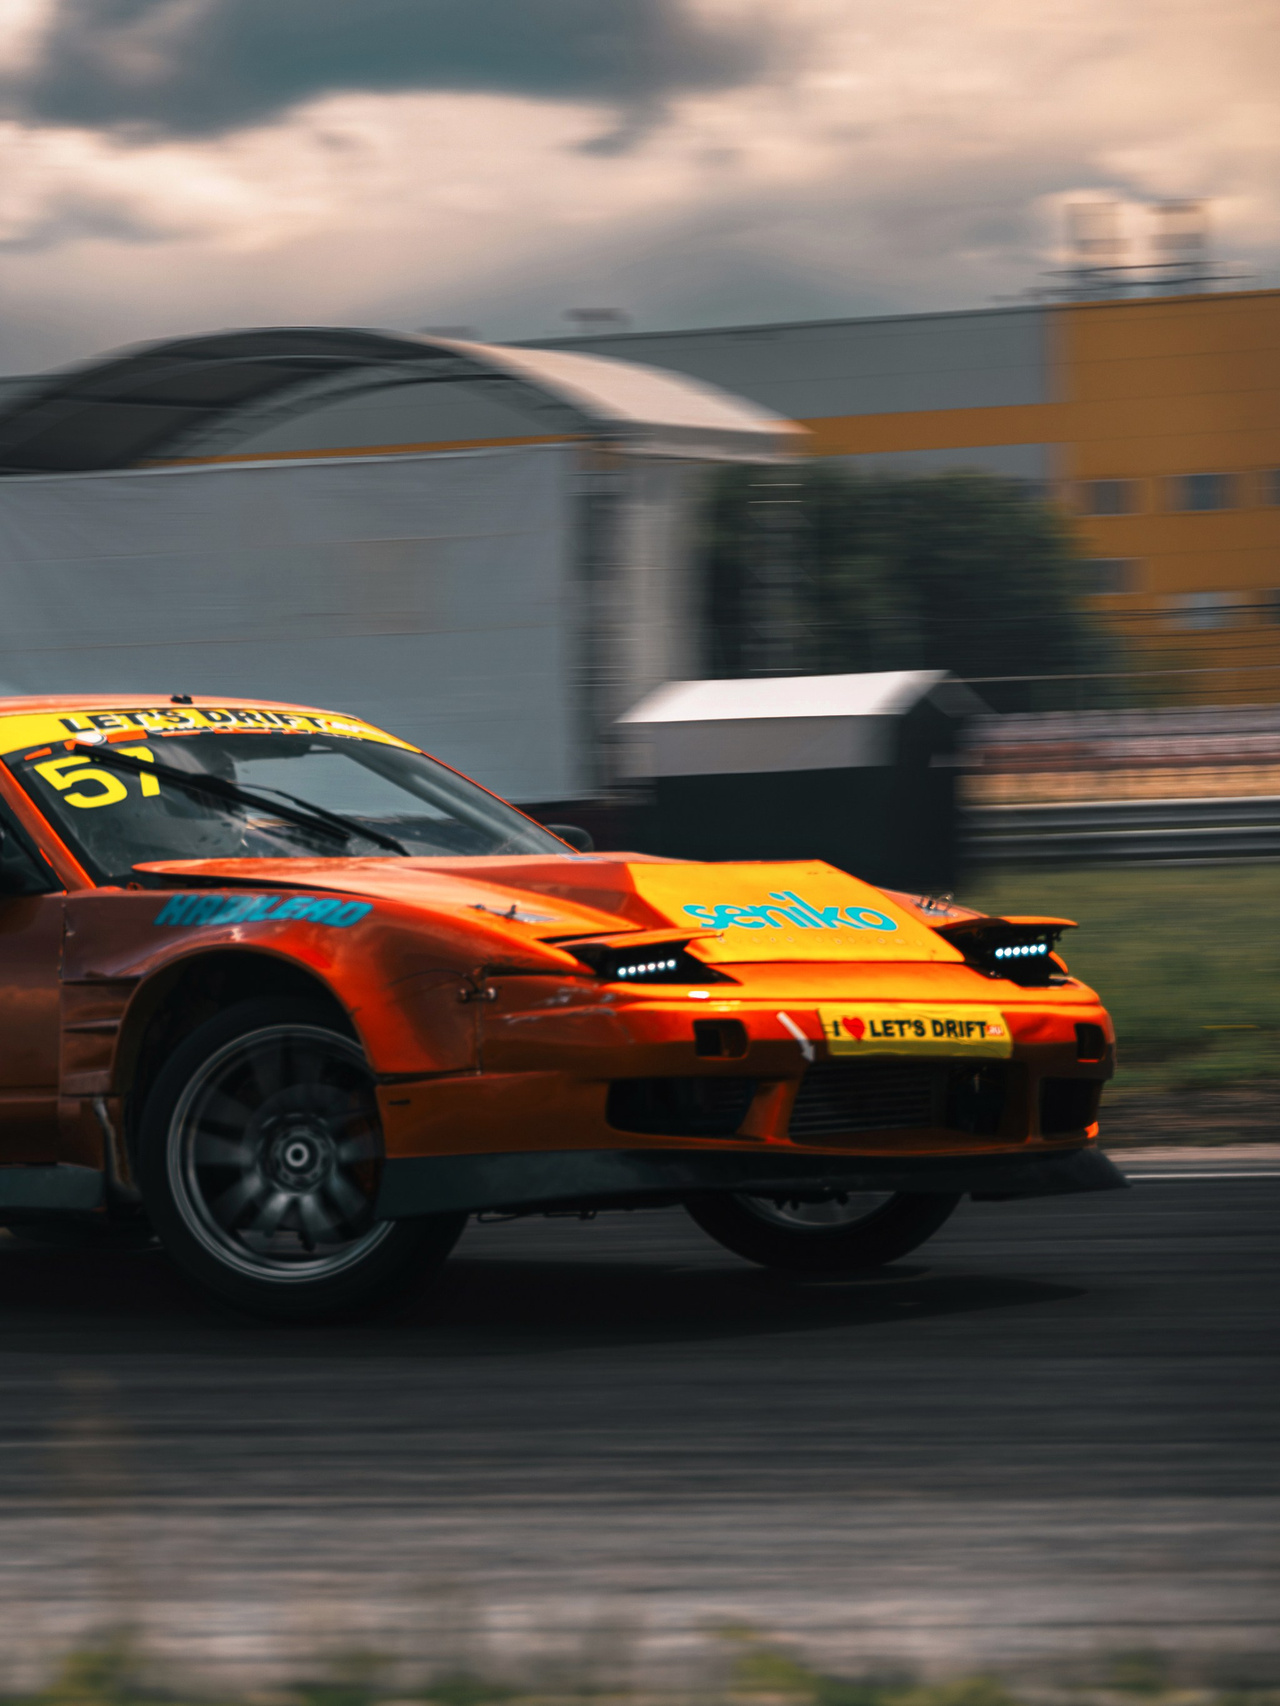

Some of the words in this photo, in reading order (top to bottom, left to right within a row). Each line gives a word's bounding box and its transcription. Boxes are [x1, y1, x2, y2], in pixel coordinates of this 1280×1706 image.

[60, 710, 194, 733] LET'S
[196, 709, 327, 732] DRIFT
[34, 745, 161, 809] 57
[683, 891, 898, 932] seniko
[834, 1020, 841, 1037] I
[870, 1019, 926, 1038] LET'S
[932, 1020, 987, 1039] DRIFT
